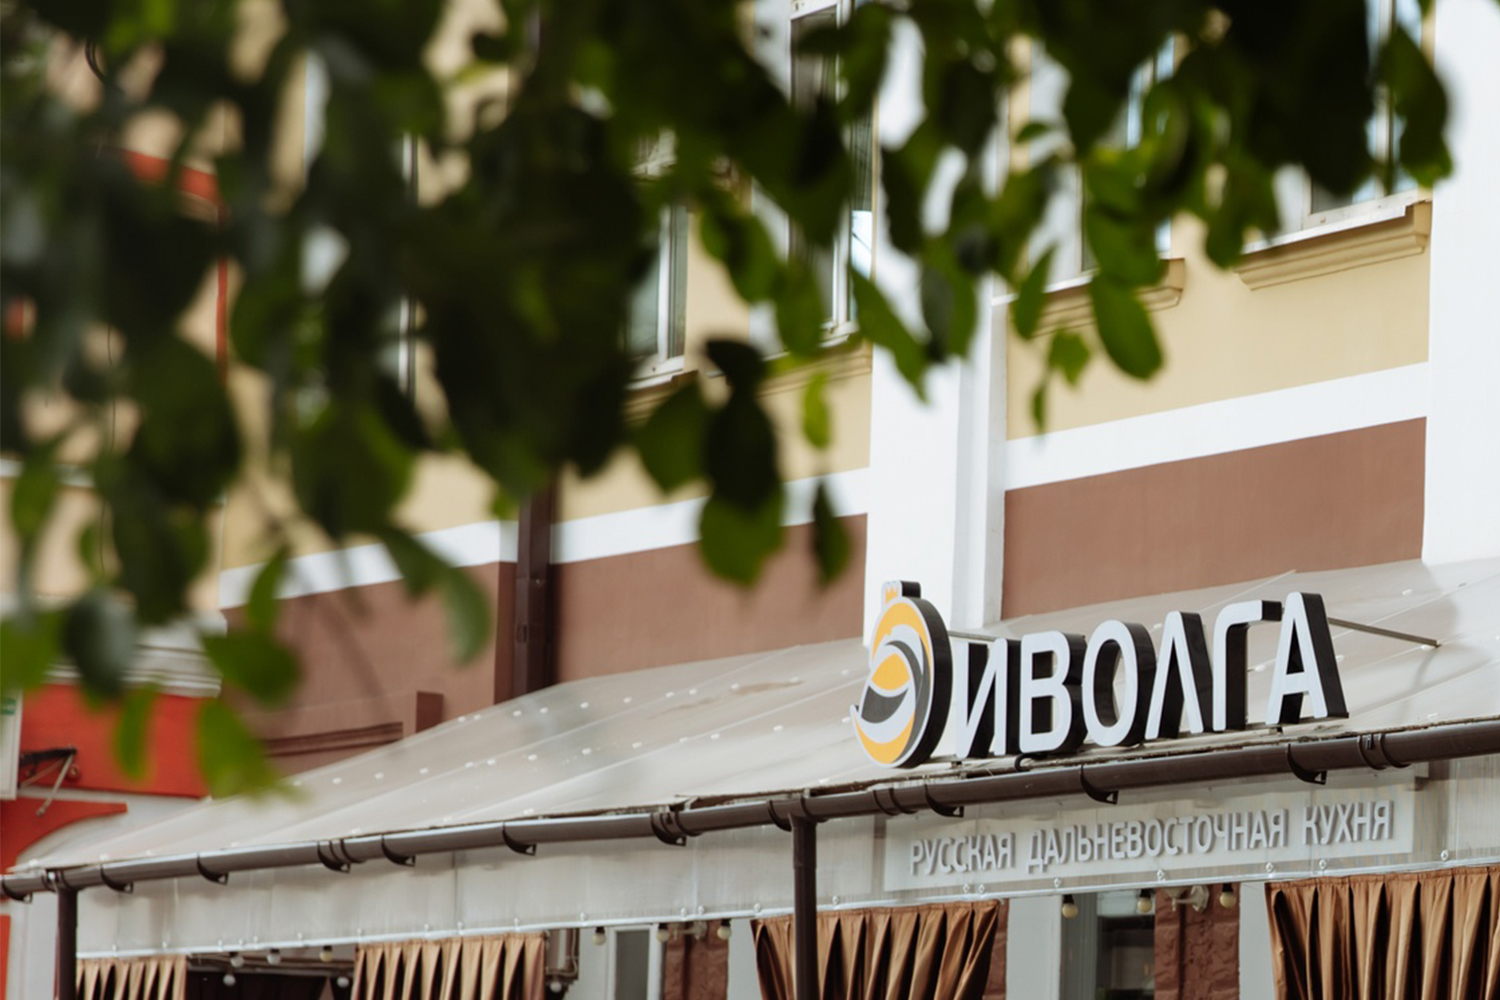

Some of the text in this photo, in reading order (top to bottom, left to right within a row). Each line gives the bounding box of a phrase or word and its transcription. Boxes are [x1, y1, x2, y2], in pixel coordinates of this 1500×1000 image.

[956, 592, 1348, 758] ИВОЛГА
[910, 801, 1394, 875] РУССКАЯ ДАЛЬНЕВОСТОЧНАЯ КУХНЯ
